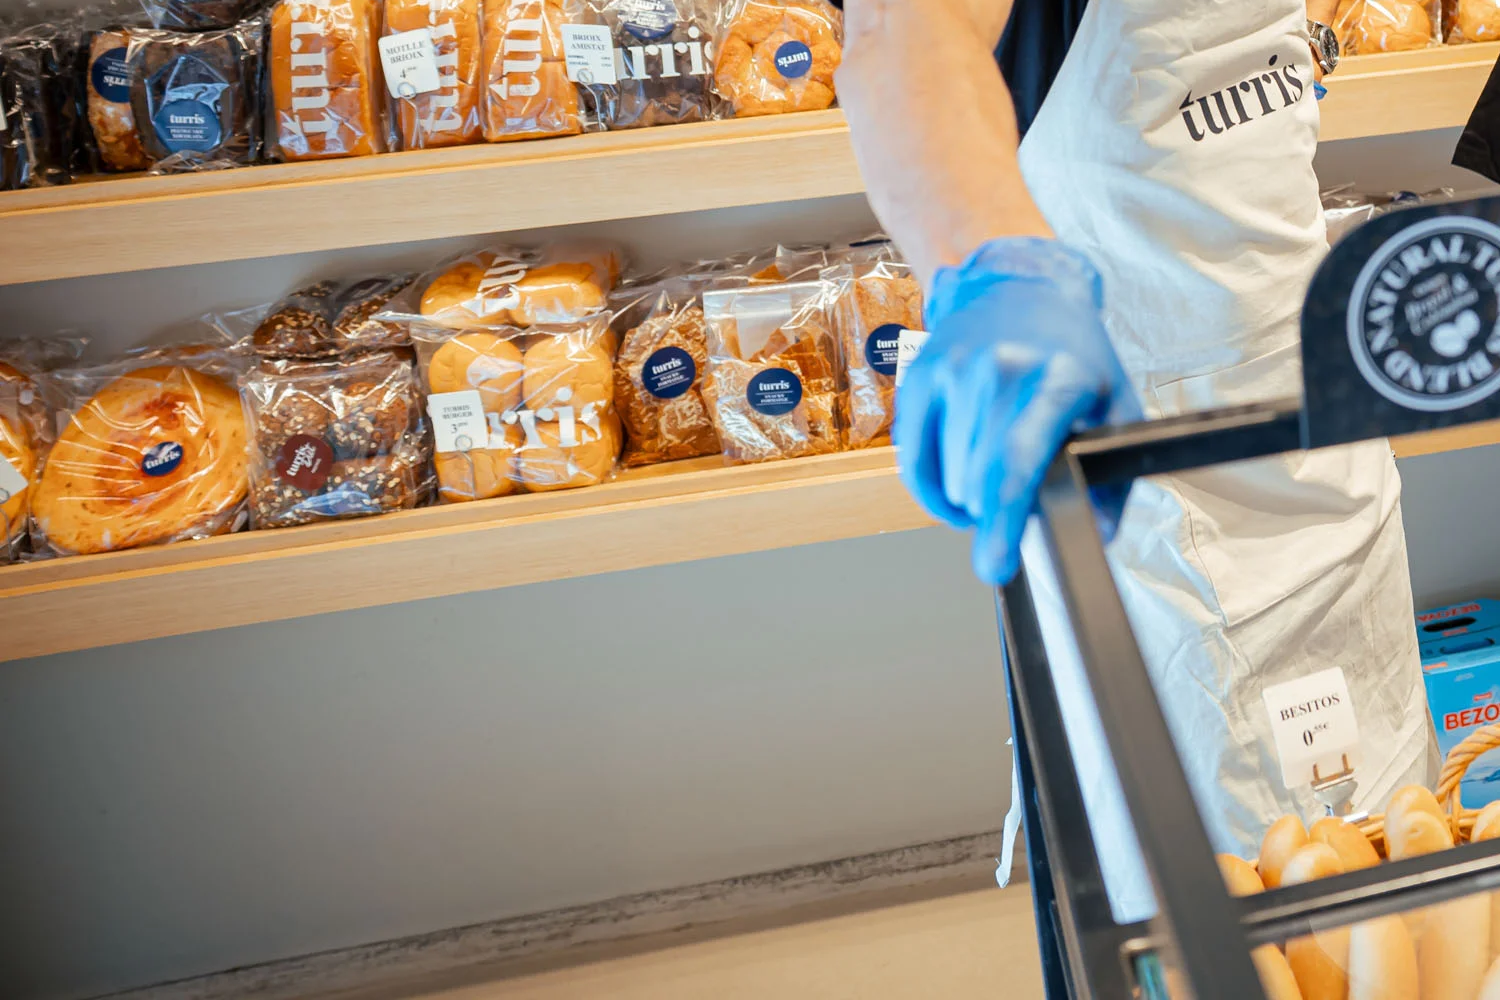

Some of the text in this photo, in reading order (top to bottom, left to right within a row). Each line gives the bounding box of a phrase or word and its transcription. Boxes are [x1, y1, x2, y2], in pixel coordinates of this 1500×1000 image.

[778, 50, 809, 68] turris
[1179, 54, 1304, 142] turris
[169, 114, 205, 124] turris
[652, 357, 682, 375] turris
[759, 380, 790, 391] turris
[1280, 693, 1340, 720] BESITOS
